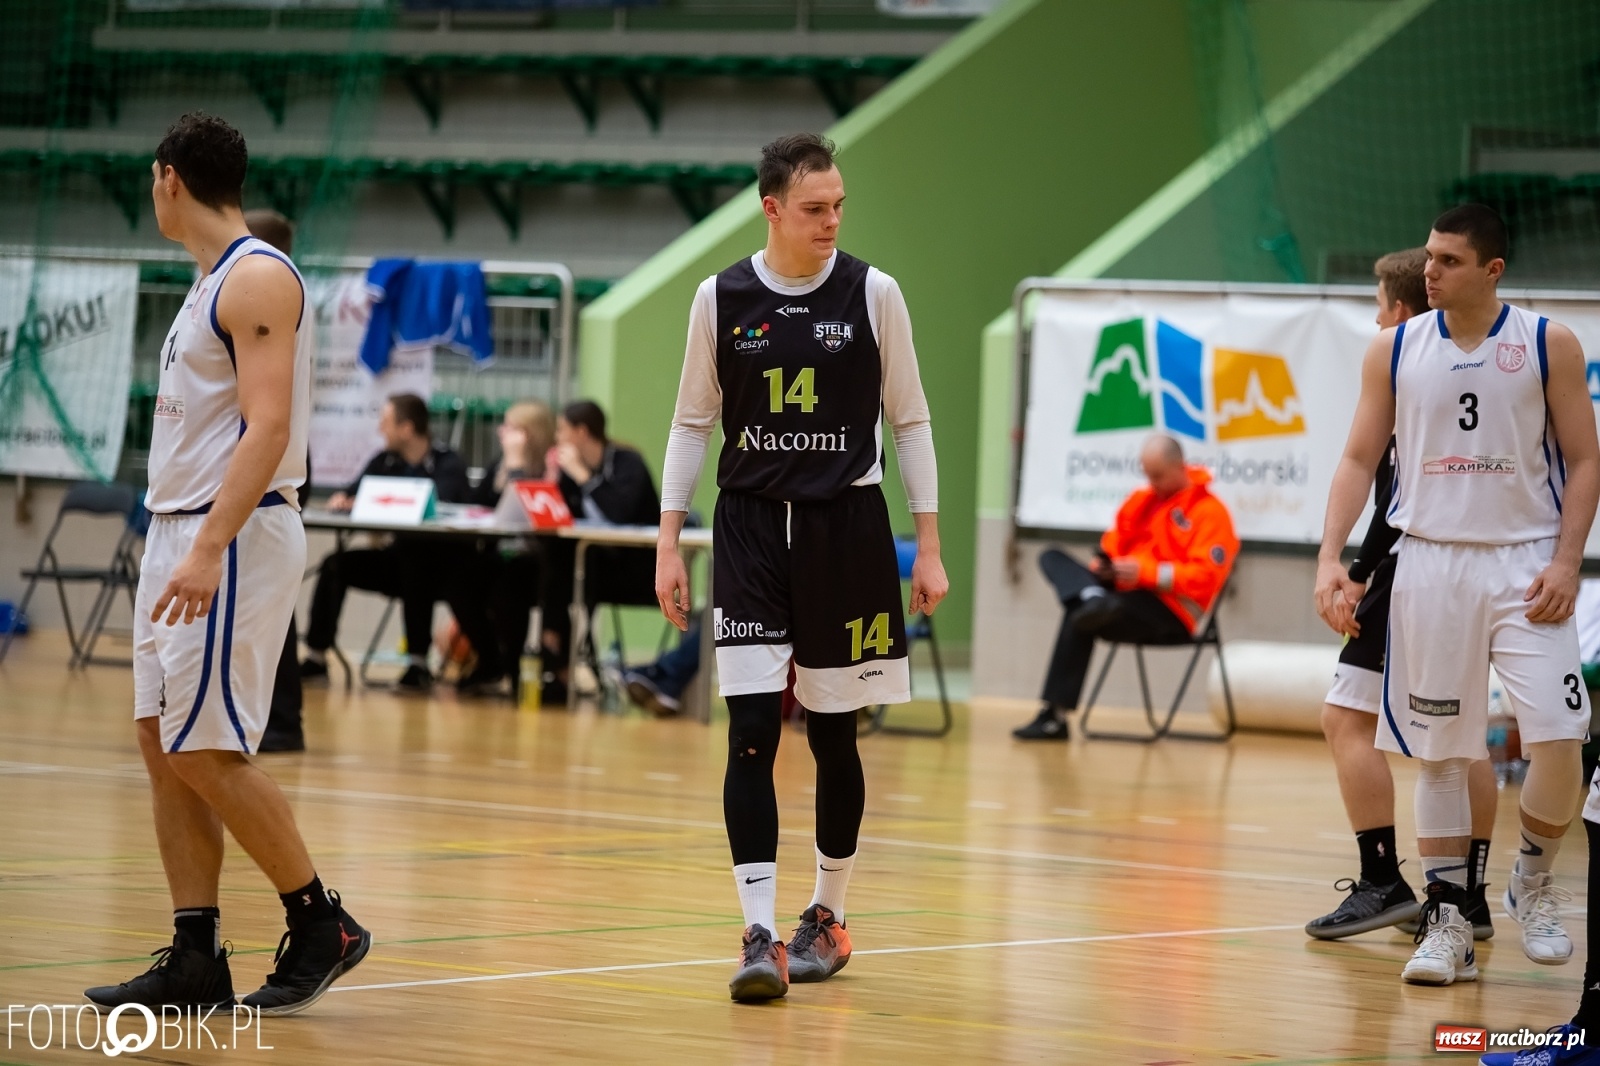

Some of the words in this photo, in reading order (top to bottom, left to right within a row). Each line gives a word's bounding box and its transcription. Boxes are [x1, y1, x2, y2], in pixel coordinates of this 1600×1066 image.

[734, 339, 769, 350] Cieszyn
[815, 324, 852, 339] STELA
[763, 367, 818, 413] 14
[1458, 392, 1479, 431] 3
[742, 425, 848, 451] Nacomi
[1447, 462, 1504, 472] KAMPKA
[845, 613, 894, 661] 14
[1563, 673, 1582, 710] 3
